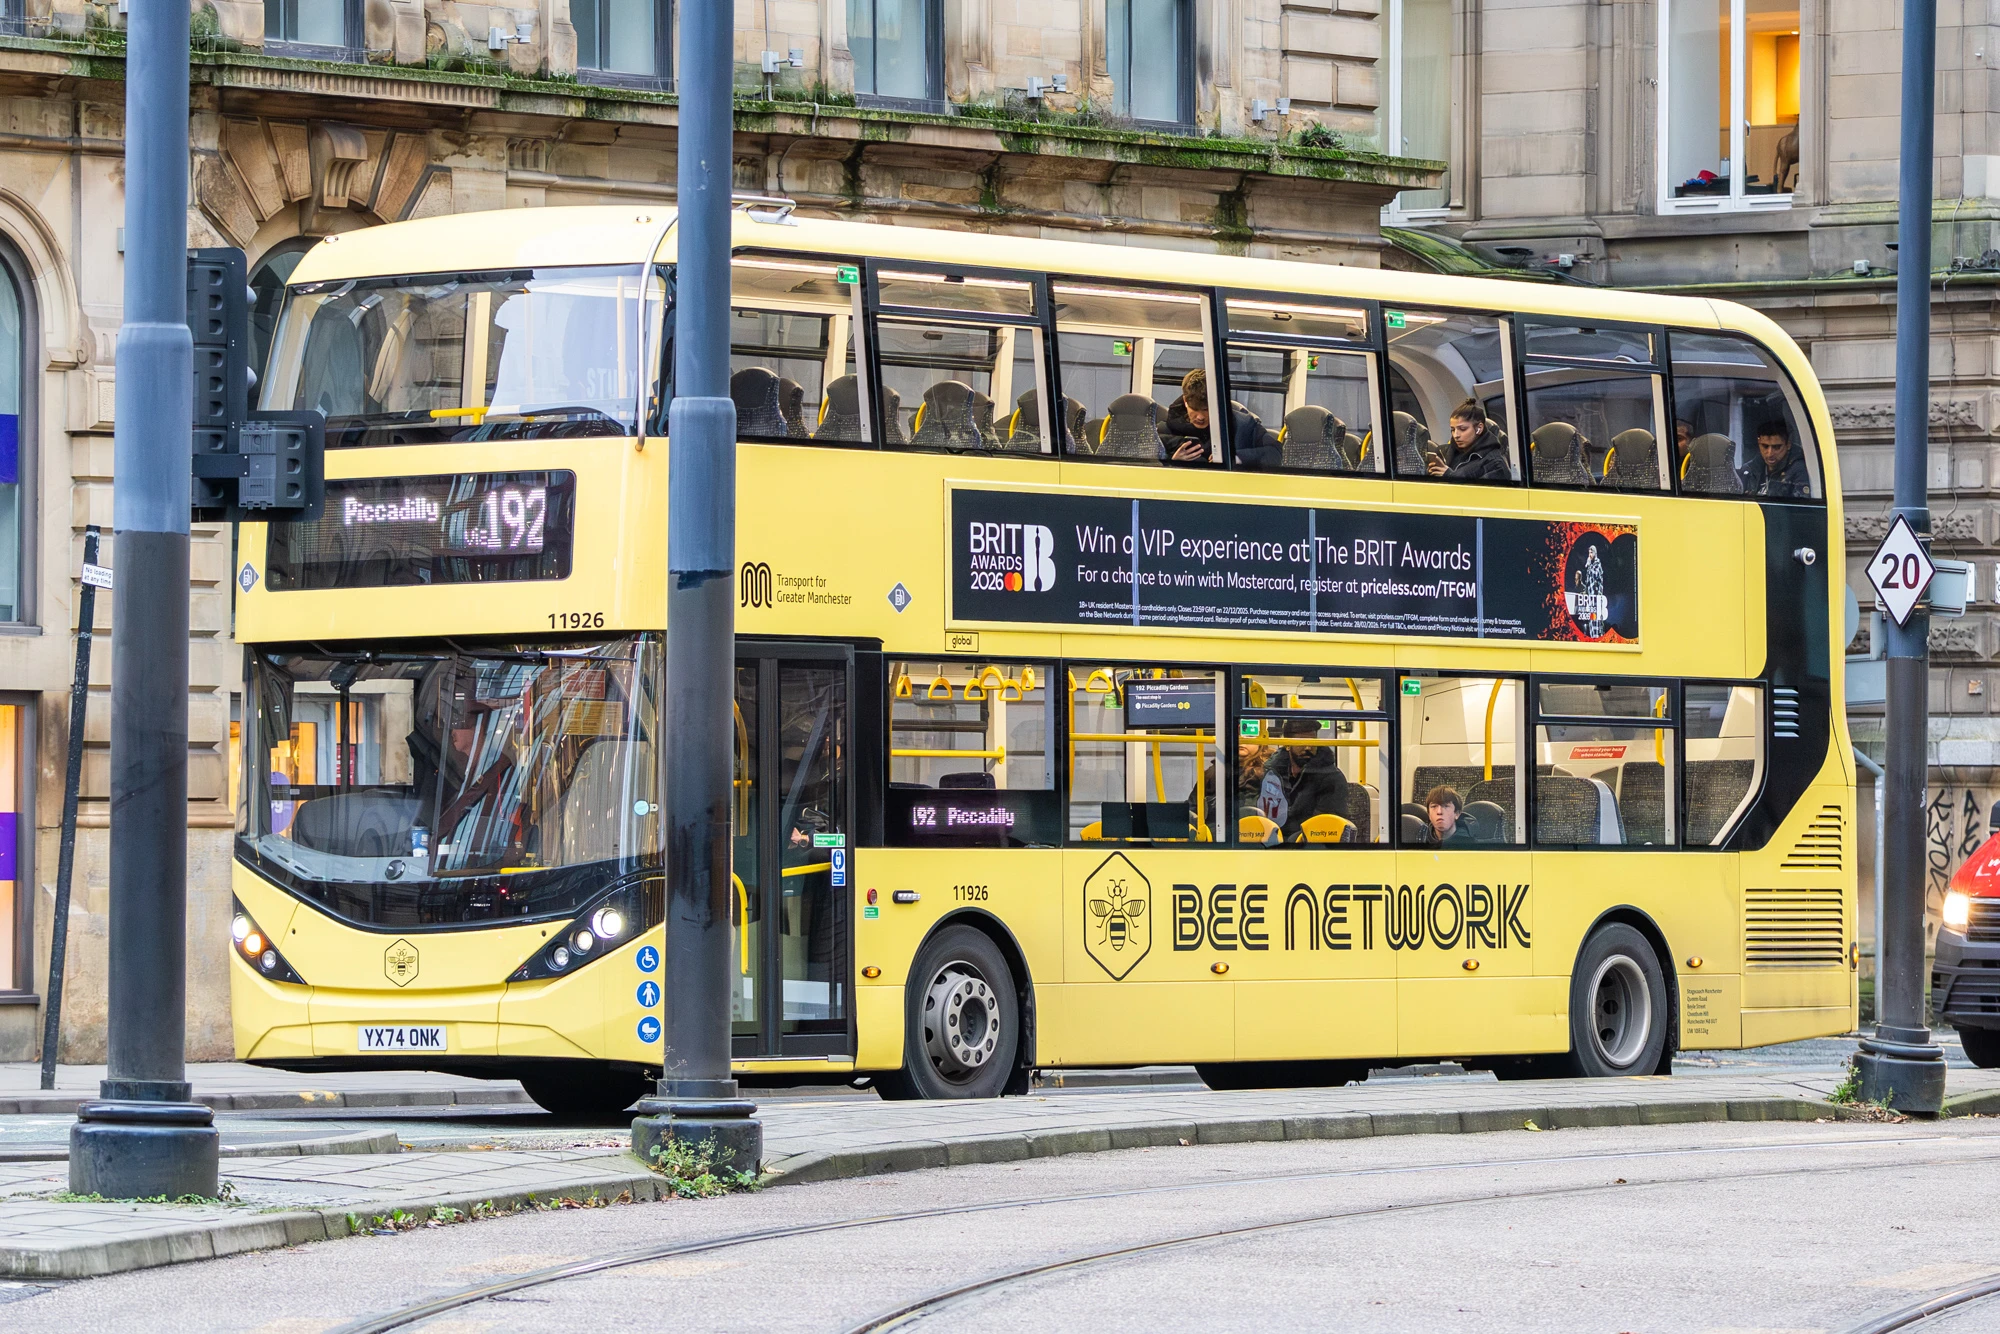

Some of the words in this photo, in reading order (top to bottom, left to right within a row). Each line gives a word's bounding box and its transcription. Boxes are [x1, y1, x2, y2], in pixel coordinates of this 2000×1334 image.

[587, 368, 636, 398] STUY
[344, 497, 439, 525] Piccadilly
[486, 488, 546, 548] 192
[970, 522, 1022, 554] BRIT
[1076, 524, 1116, 554] Win
[1141, 528, 1174, 557] VIP
[1180, 534, 1282, 565] experience
[1288, 541, 1310, 563] at
[1314, 536, 1348, 565] The
[1354, 538, 1397, 567] BRIT
[1400, 542, 1471, 570] Awards
[970, 555, 1022, 571] AWARDS
[1881, 553, 1920, 590] 20
[777, 574, 814, 590] Transport
[816, 576, 827, 588] for
[970, 572, 1004, 590] 2026
[1078, 564, 1097, 584] For
[1100, 570, 1109, 584] a
[1112, 566, 1156, 586] chance
[1159, 572, 1172, 586] to
[1174, 570, 1195, 588] win
[1197, 571, 1224, 588] with
[1227, 572, 1297, 593] Mastercard,
[1300, 576, 1343, 596] register
[1346, 579, 1358, 594] at
[1361, 577, 1476, 598] priceless.com/TFGM
[777, 590, 805, 603] Greater
[808, 591, 852, 605] Manchester
[1578, 594, 1596, 606] BRIT
[548, 612, 604, 629] 11926
[1436, 624, 1450, 632] Privacy
[952, 635, 972, 648] global
[913, 807, 936, 826] 192
[948, 808, 1014, 826] Piccadilly
[953, 885, 988, 900] 11926
[1172, 884, 1269, 951] BEE
[1284, 883, 1531, 951] NETWORK
[364, 1028, 404, 1046] YX74
[410, 1028, 440, 1046] ONK
